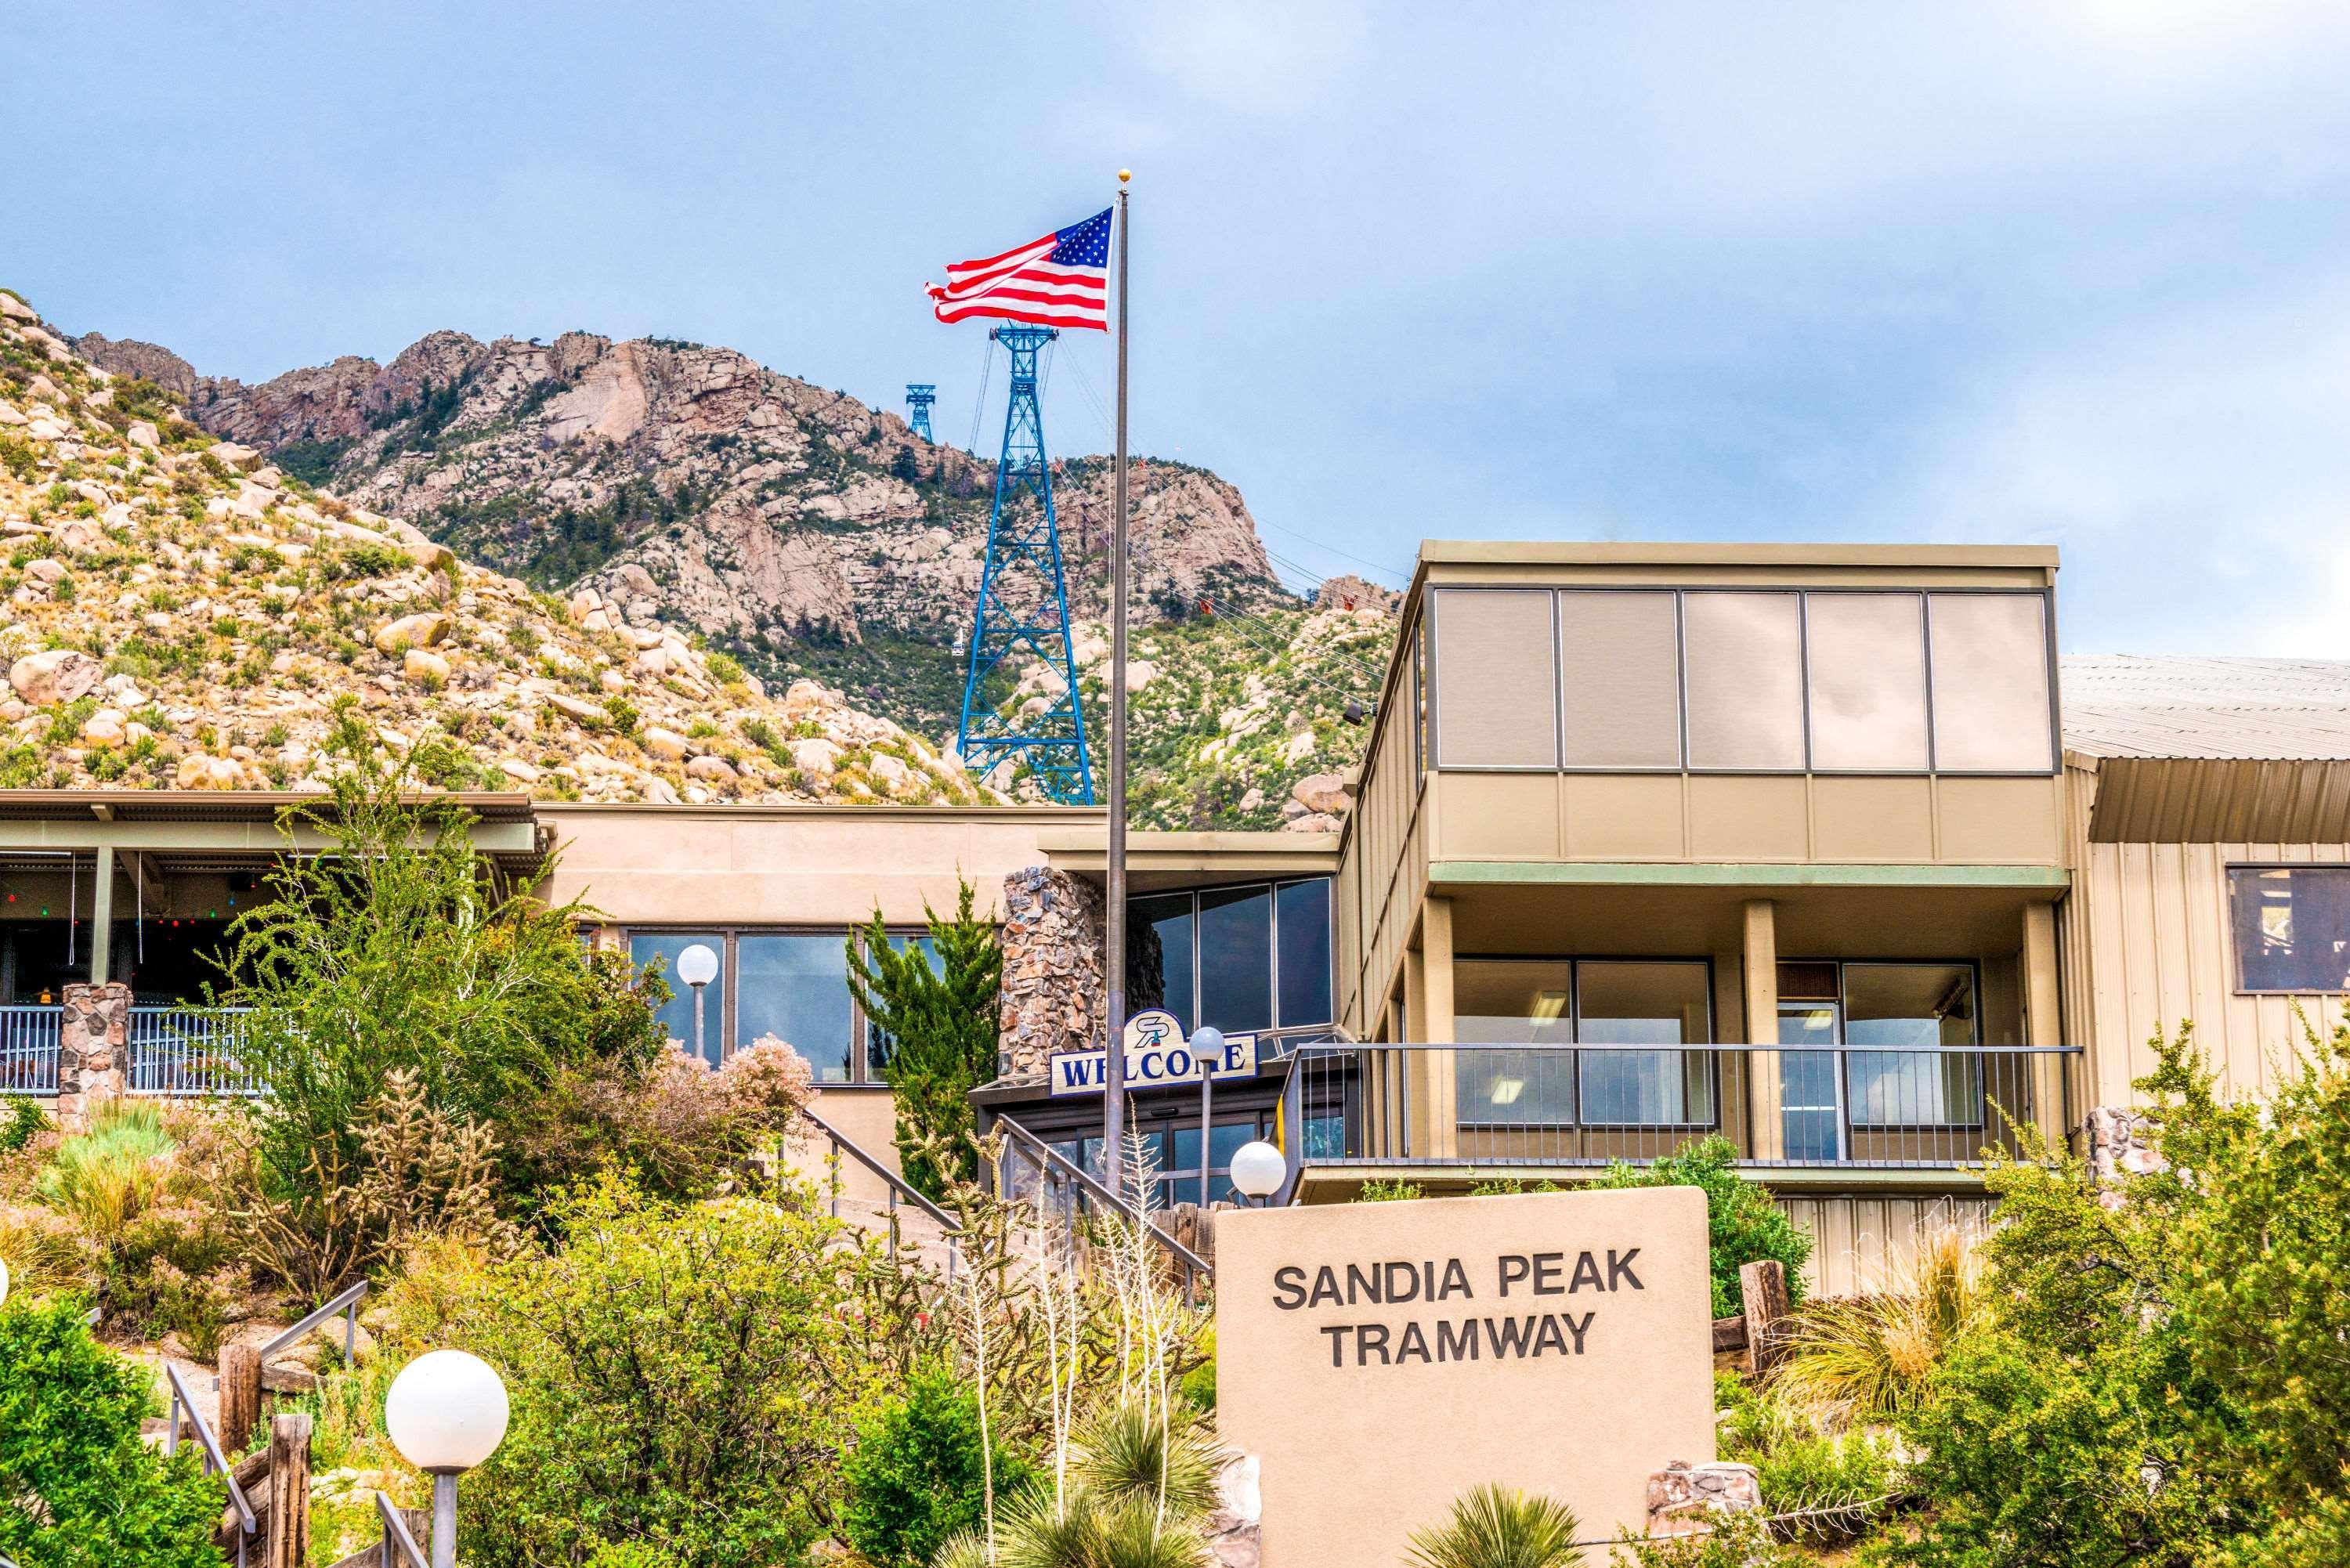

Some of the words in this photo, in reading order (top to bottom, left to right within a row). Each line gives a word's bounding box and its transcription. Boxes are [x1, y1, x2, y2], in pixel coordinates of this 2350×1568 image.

[1273, 1258, 1474, 1310] SANDIA
[1499, 1248, 1645, 1298] PEAK
[1320, 1312, 1596, 1367] TRAMWAY
